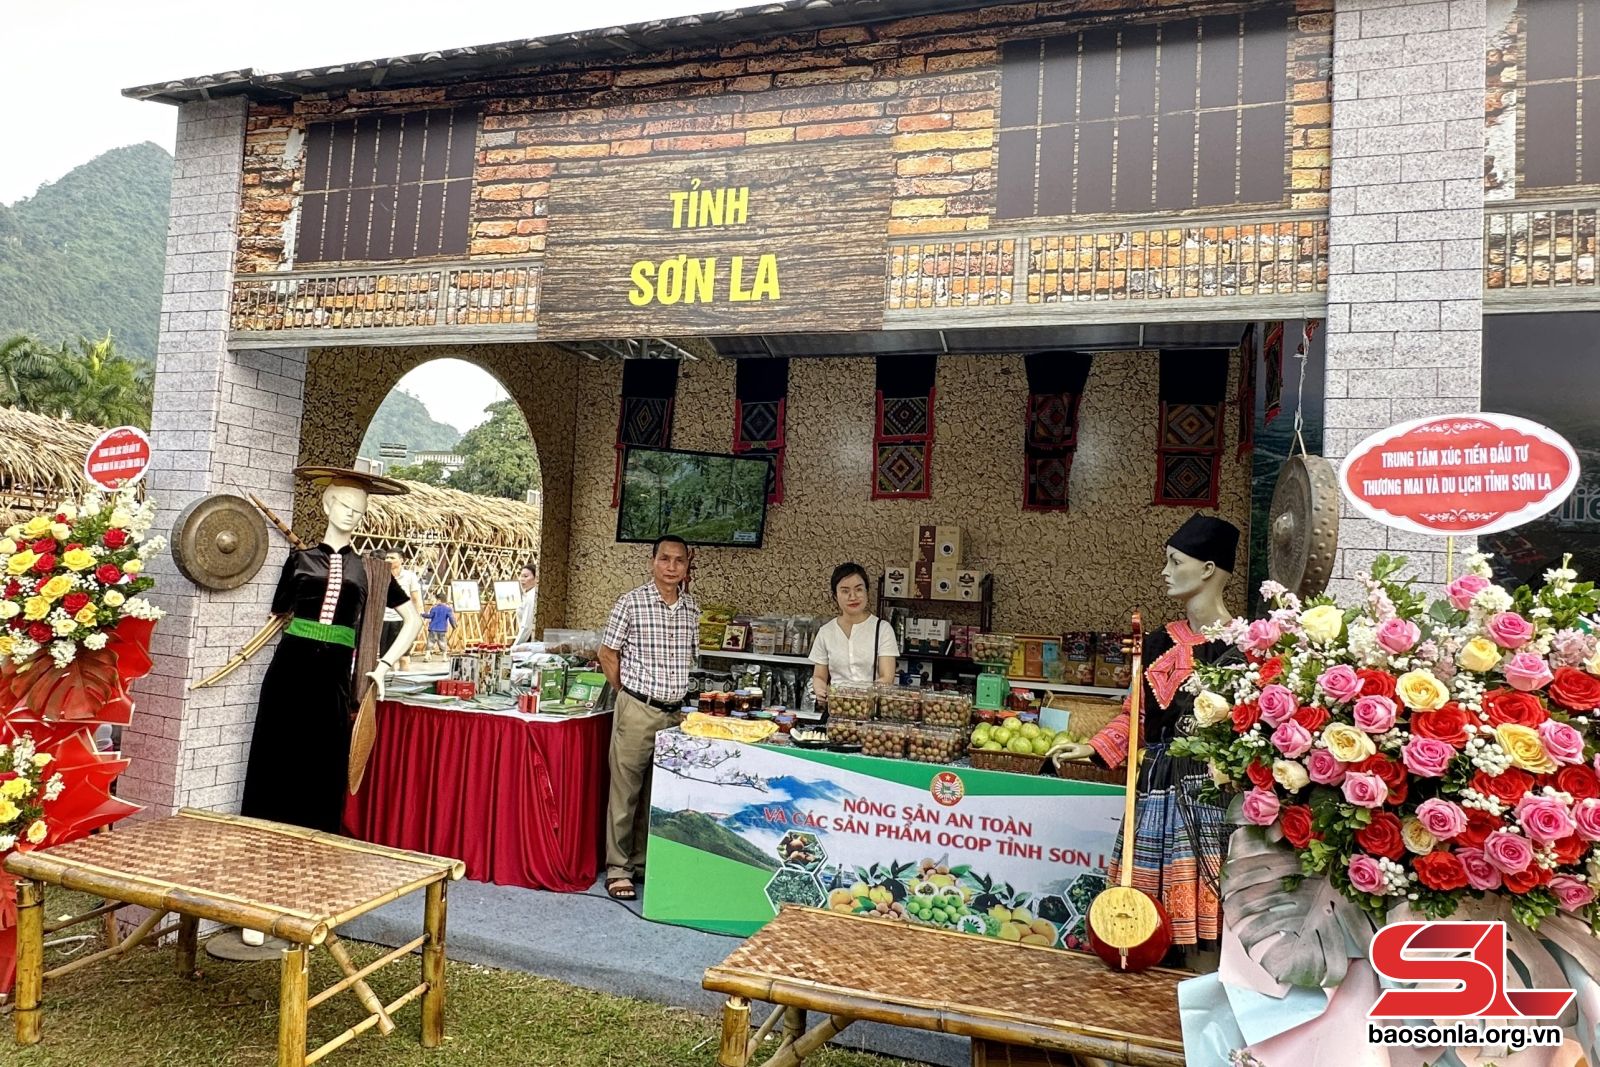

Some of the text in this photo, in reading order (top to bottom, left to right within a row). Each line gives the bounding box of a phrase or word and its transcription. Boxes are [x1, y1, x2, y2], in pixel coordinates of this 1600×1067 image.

[669, 178, 749, 229] TỈNH
[628, 253, 781, 306] SƠN LA
[1381, 440, 1530, 468] TRUNG TÂM XÚC TIẾN ĐẦU TƯ
[1363, 478, 1402, 496] THƯƠNG
[1425, 474, 1441, 494] VÀ
[1441, 477, 1456, 493] DU
[1458, 476, 1482, 497] LỊCH
[1484, 470, 1509, 492] TỈNH
[1511, 472, 1535, 491] SƠN
[1537, 472, 1552, 490] LA
[763, 806, 787, 824] VÀ
[792, 809, 828, 829] CÁC
[832, 815, 870, 836] SẢN
[875, 821, 932, 844] PHẨM
[937, 832, 992, 852] OCOP
[996, 836, 1043, 860] TỈNH
[1048, 847, 1091, 867] SƠN
[843, 797, 1033, 837] NÔNG SẢN AN TOÀN
